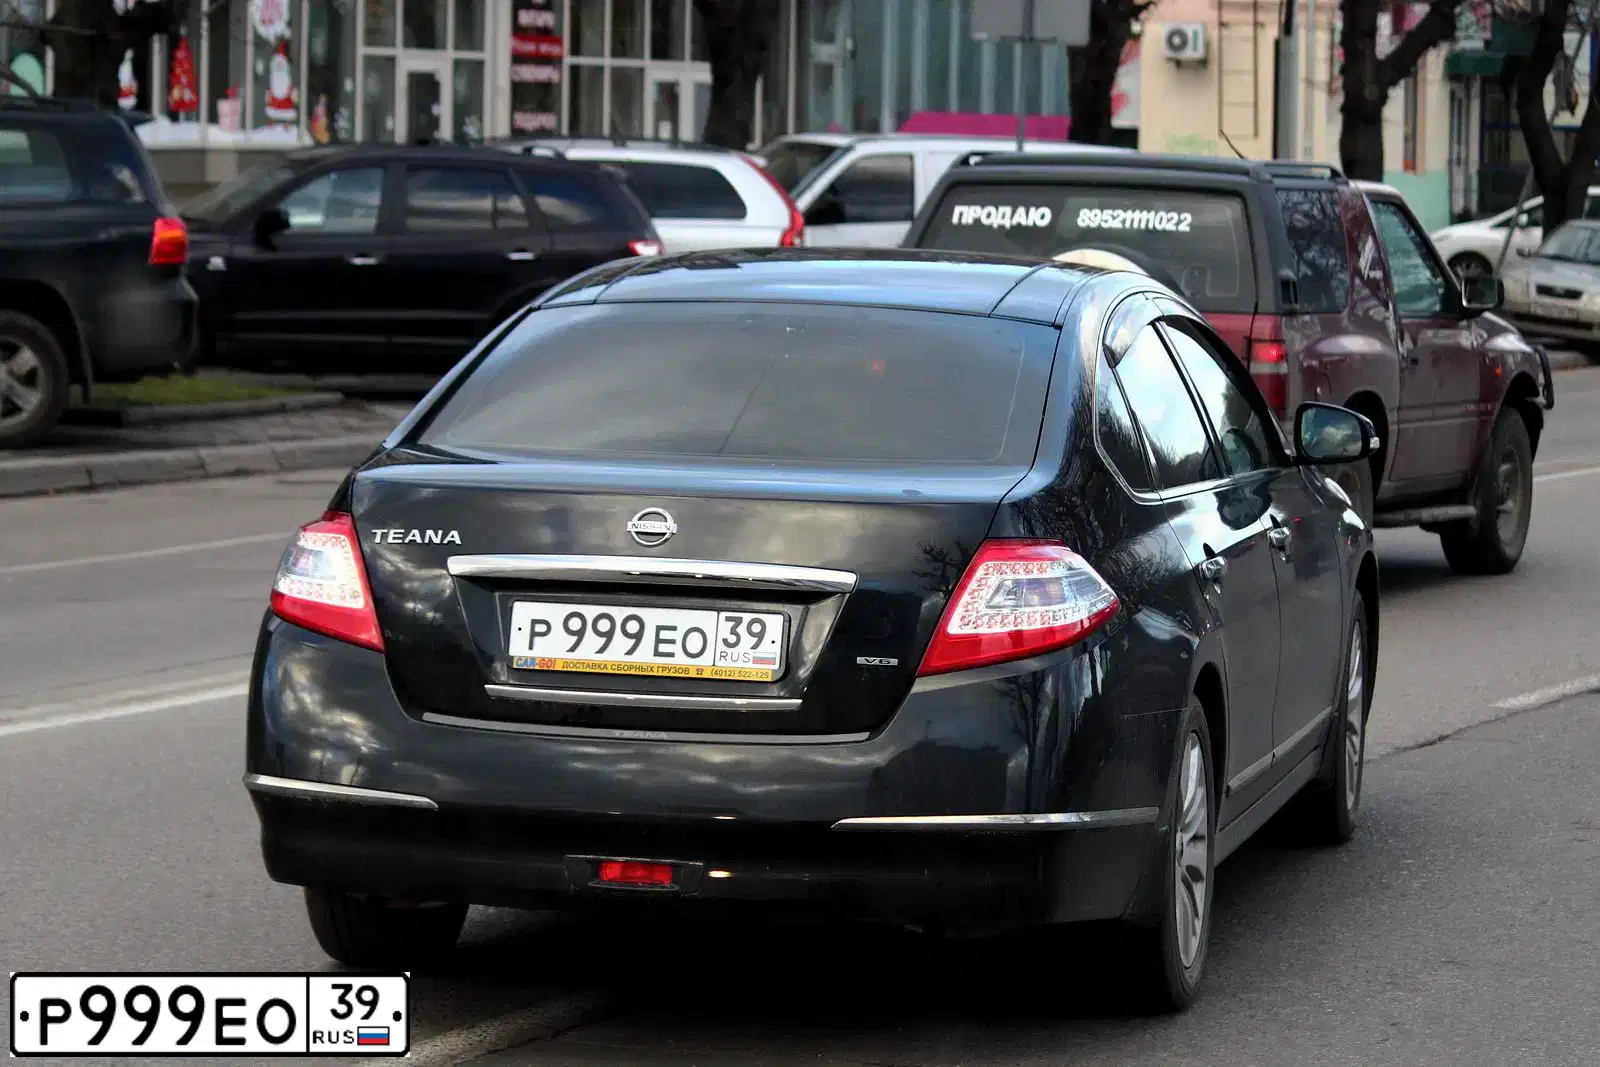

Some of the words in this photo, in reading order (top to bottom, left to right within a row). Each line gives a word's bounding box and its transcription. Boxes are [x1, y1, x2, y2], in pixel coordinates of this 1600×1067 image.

[952, 205, 1051, 230] ПРОДАЮ
[1077, 208, 1192, 232] 89521111022
[371, 529, 462, 545] TEANA
[721, 615, 767, 650] 39
[719, 651, 751, 663] RUS
[562, 661, 608, 671] ДОСТАВКА
[610, 664, 655, 674] СБОРНЫХ
[656, 666, 690, 675] ГРУЗОВ
[710, 669, 736, 678] (4012)
[737, 671, 769, 680] 522-125
